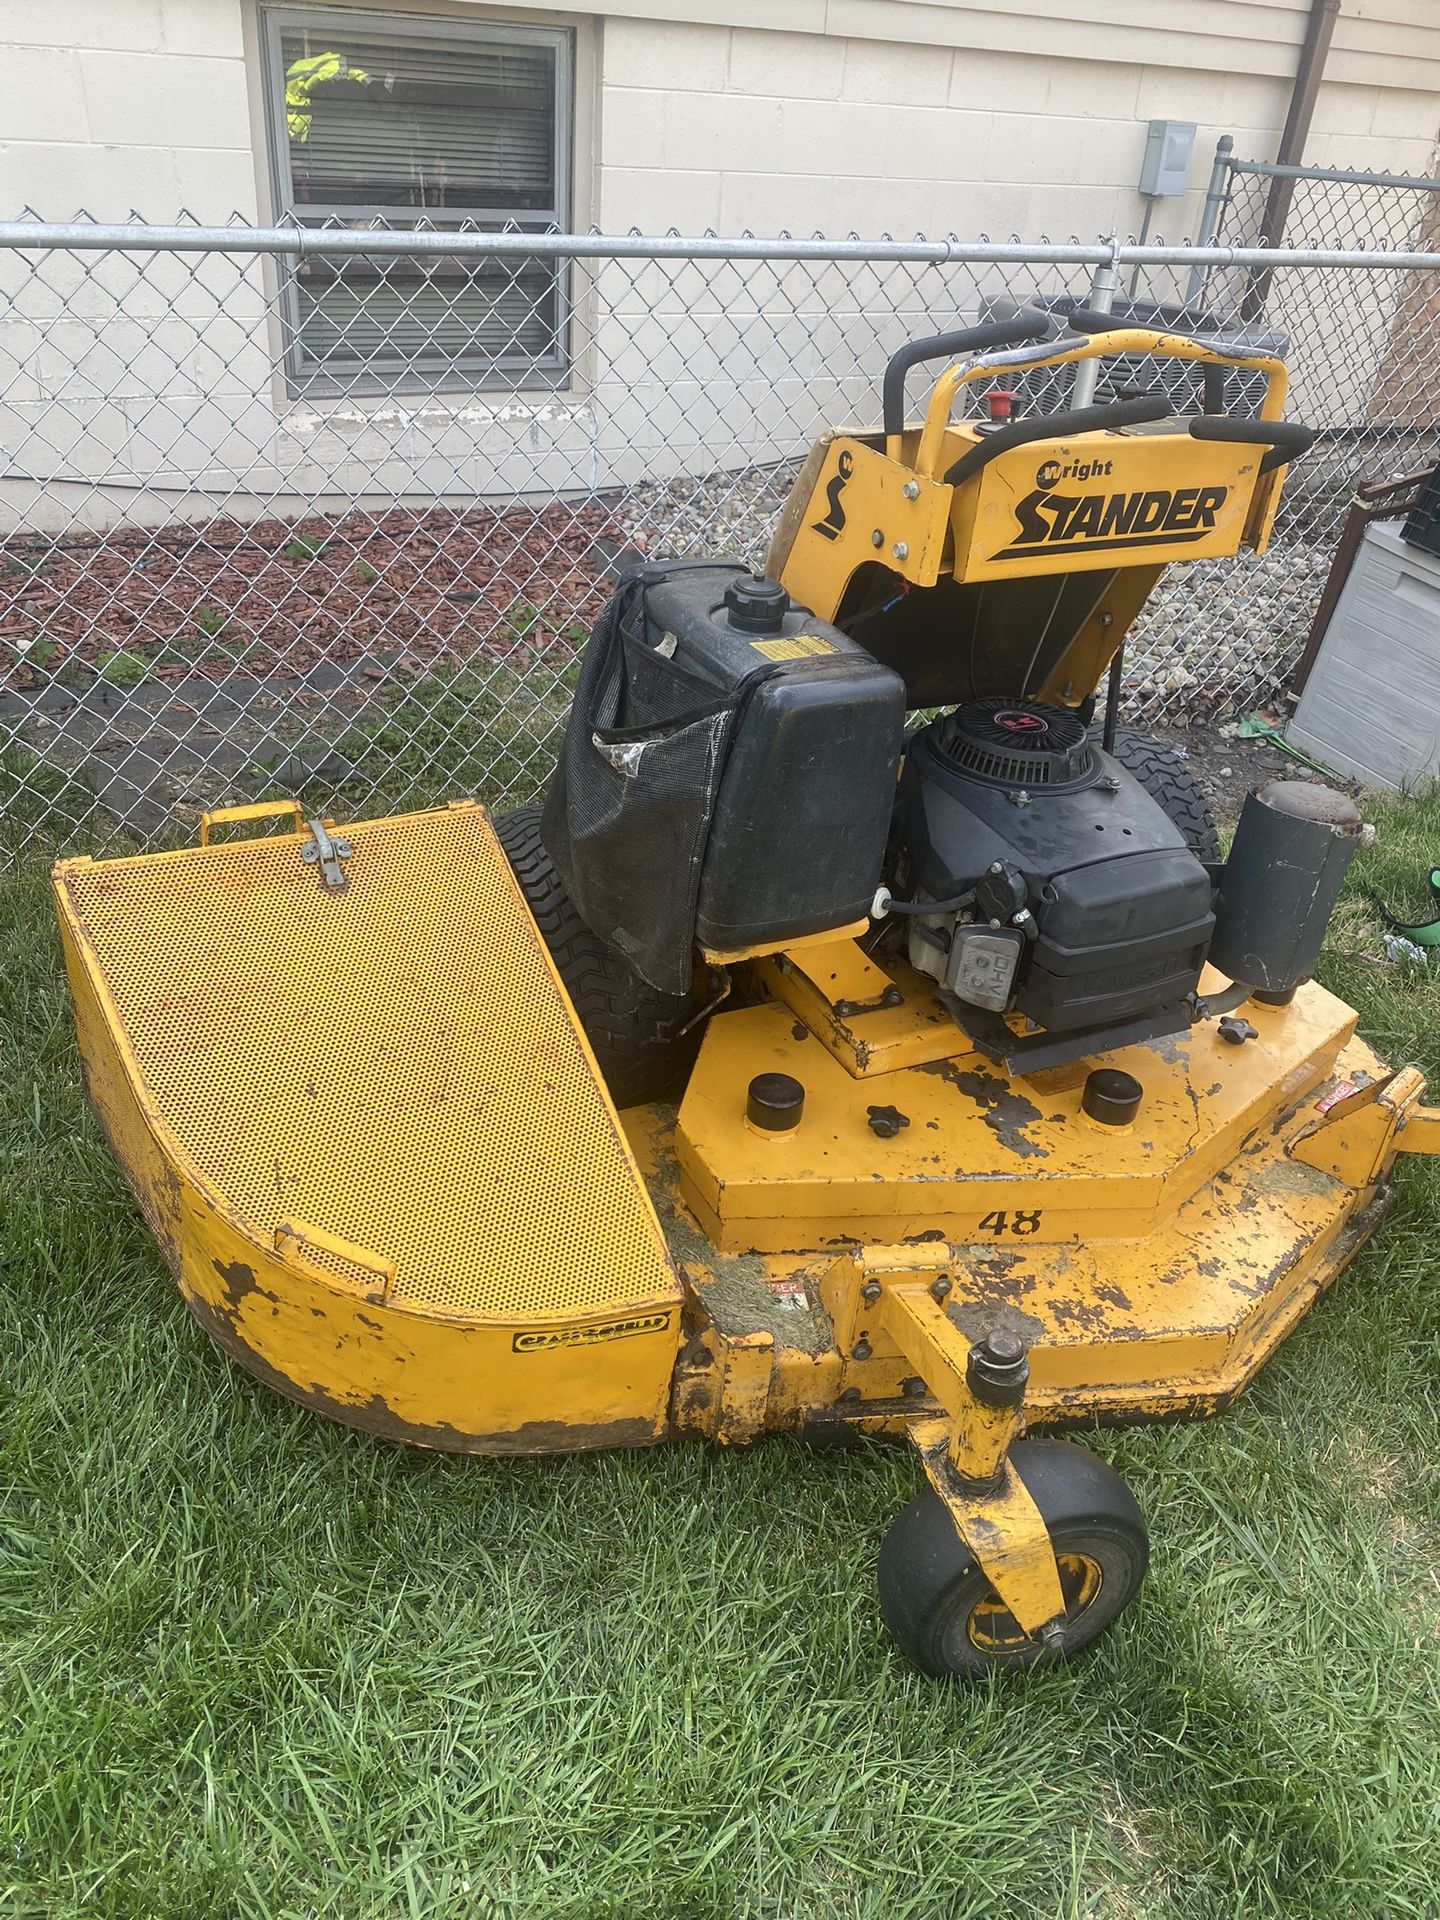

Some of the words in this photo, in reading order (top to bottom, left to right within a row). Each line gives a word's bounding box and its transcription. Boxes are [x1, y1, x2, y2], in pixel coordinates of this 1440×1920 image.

[1040, 459, 1113, 484] Wright
[1010, 487, 1228, 545] STANDER
[979, 1210, 1042, 1236] 48
